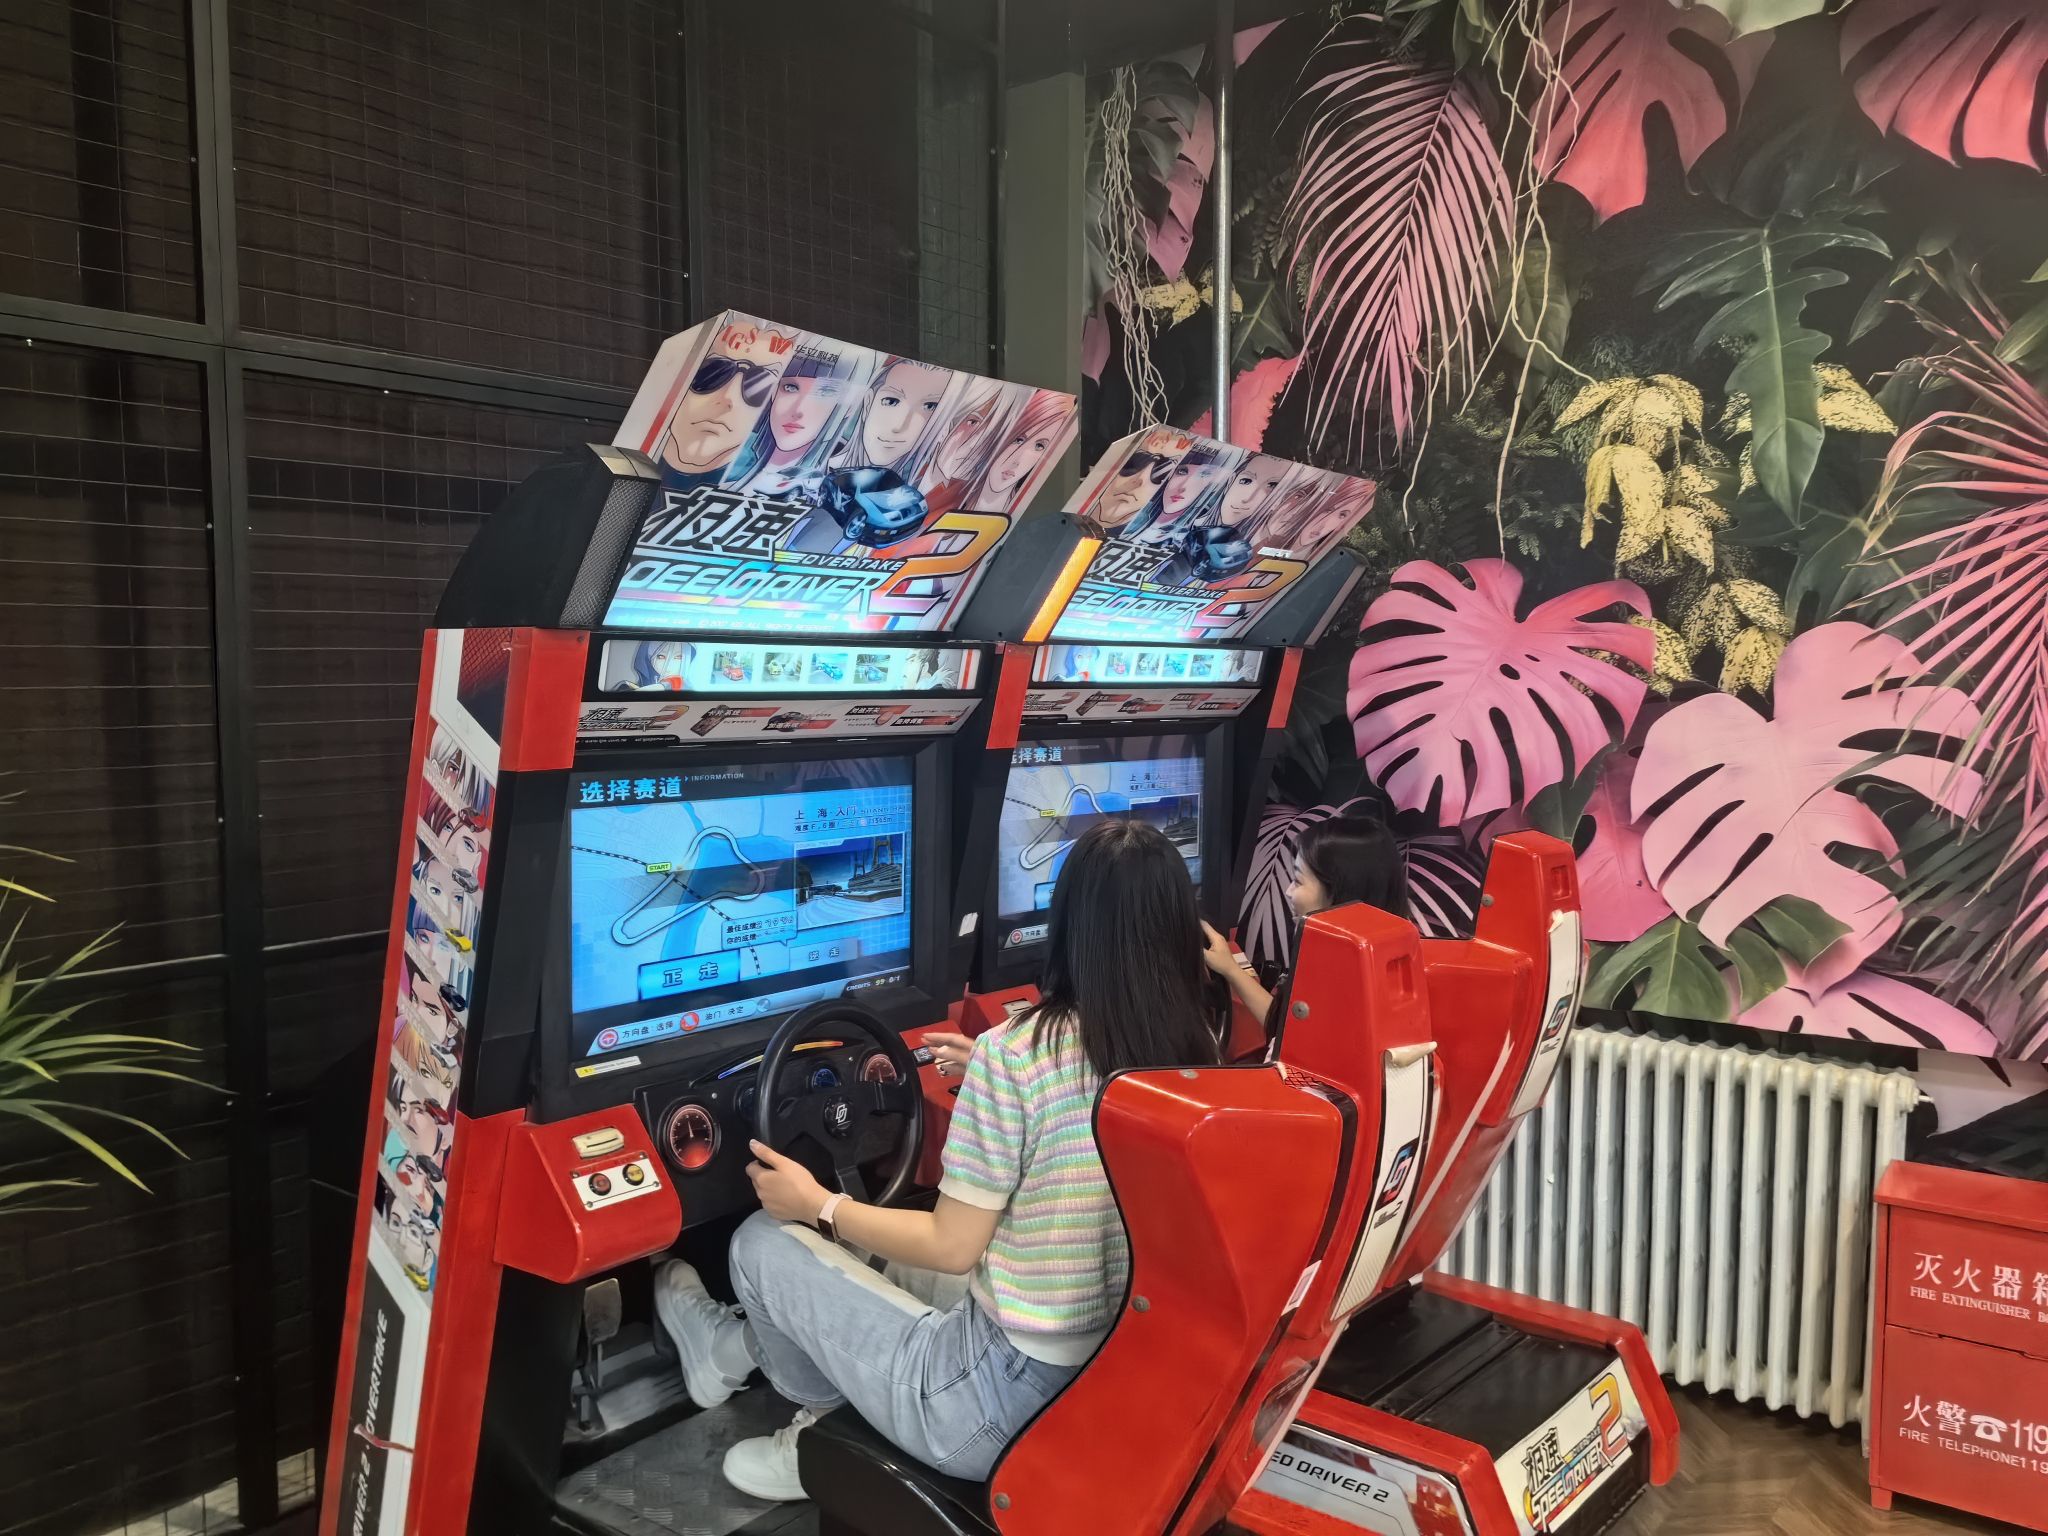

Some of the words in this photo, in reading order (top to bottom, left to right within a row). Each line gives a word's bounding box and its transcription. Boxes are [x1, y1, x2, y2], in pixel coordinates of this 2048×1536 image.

[579, 775, 683, 803] 选择赛道
[691, 772, 744, 782] INFORMATION
[650, 863, 670, 871] START
[875, 978, 886, 986] 99
[1909, 1285, 1937, 1301] FIRE
[1942, 1291, 2031, 1320] EXTINGUISHER
[366, 1308, 389, 1436] OVERTAKE
[1899, 1427, 1930, 1444] FIRE
[1903, 1394, 1966, 1436] 火警
[2009, 1418, 2048, 1455] 119
[1296, 1460, 1371, 1496] DRIVER
[1372, 1488, 1389, 1503] 2
